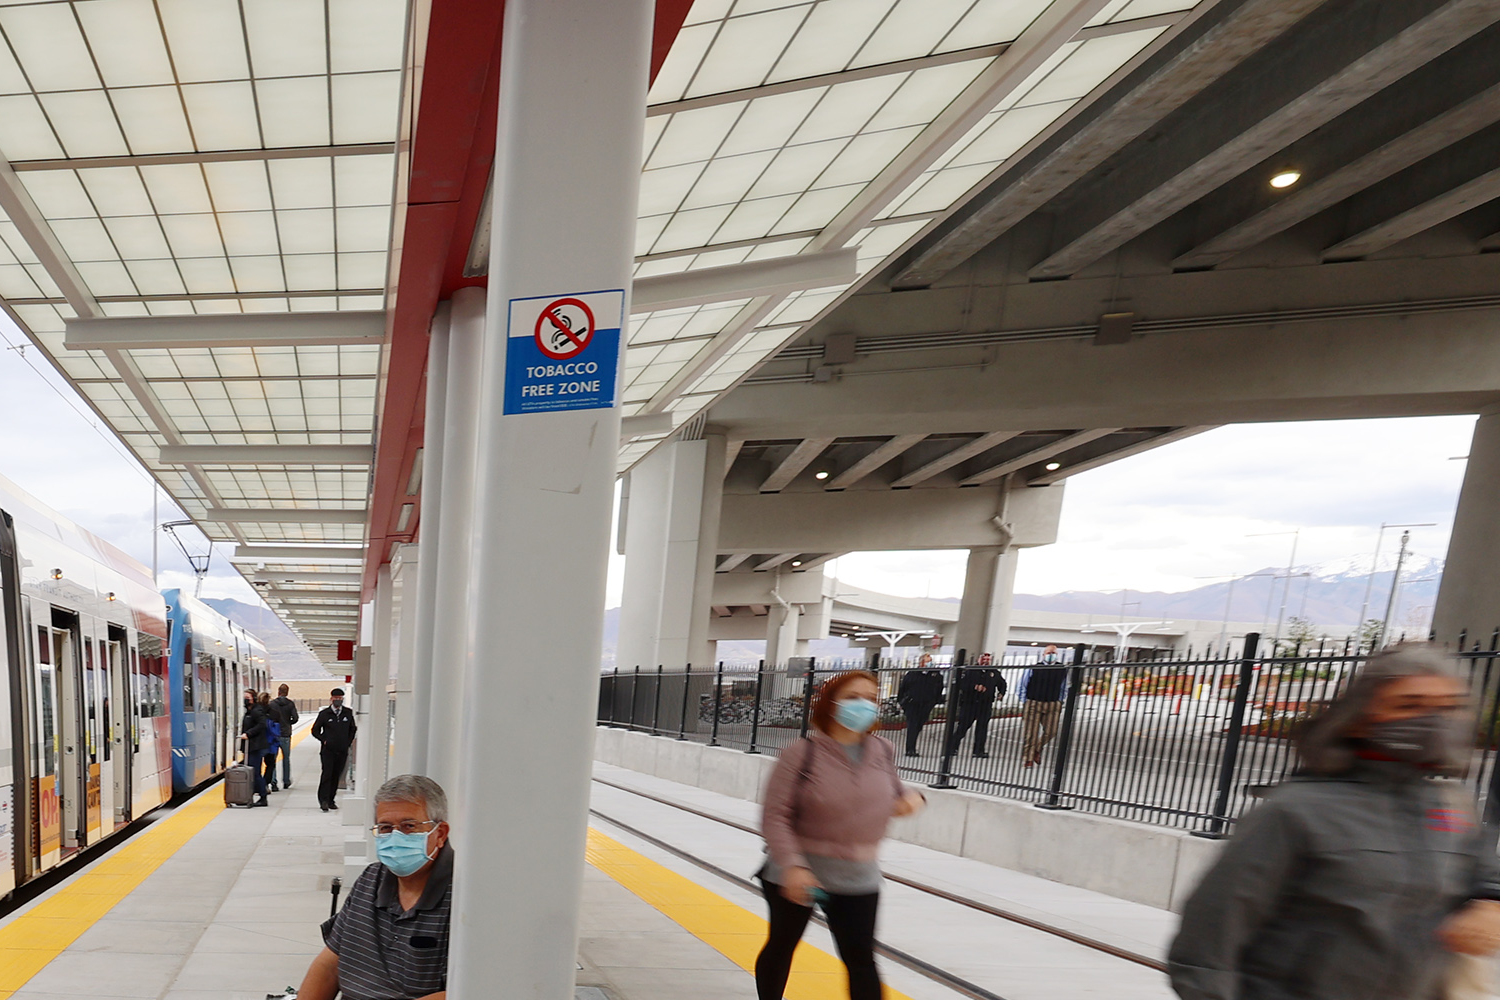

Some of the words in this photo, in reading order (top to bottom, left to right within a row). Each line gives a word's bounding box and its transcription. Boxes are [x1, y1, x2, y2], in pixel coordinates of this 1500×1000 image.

[526, 362, 598, 378] TOBACCO
[522, 384, 554, 397] FREE
[558, 380, 600, 395] ZONE
